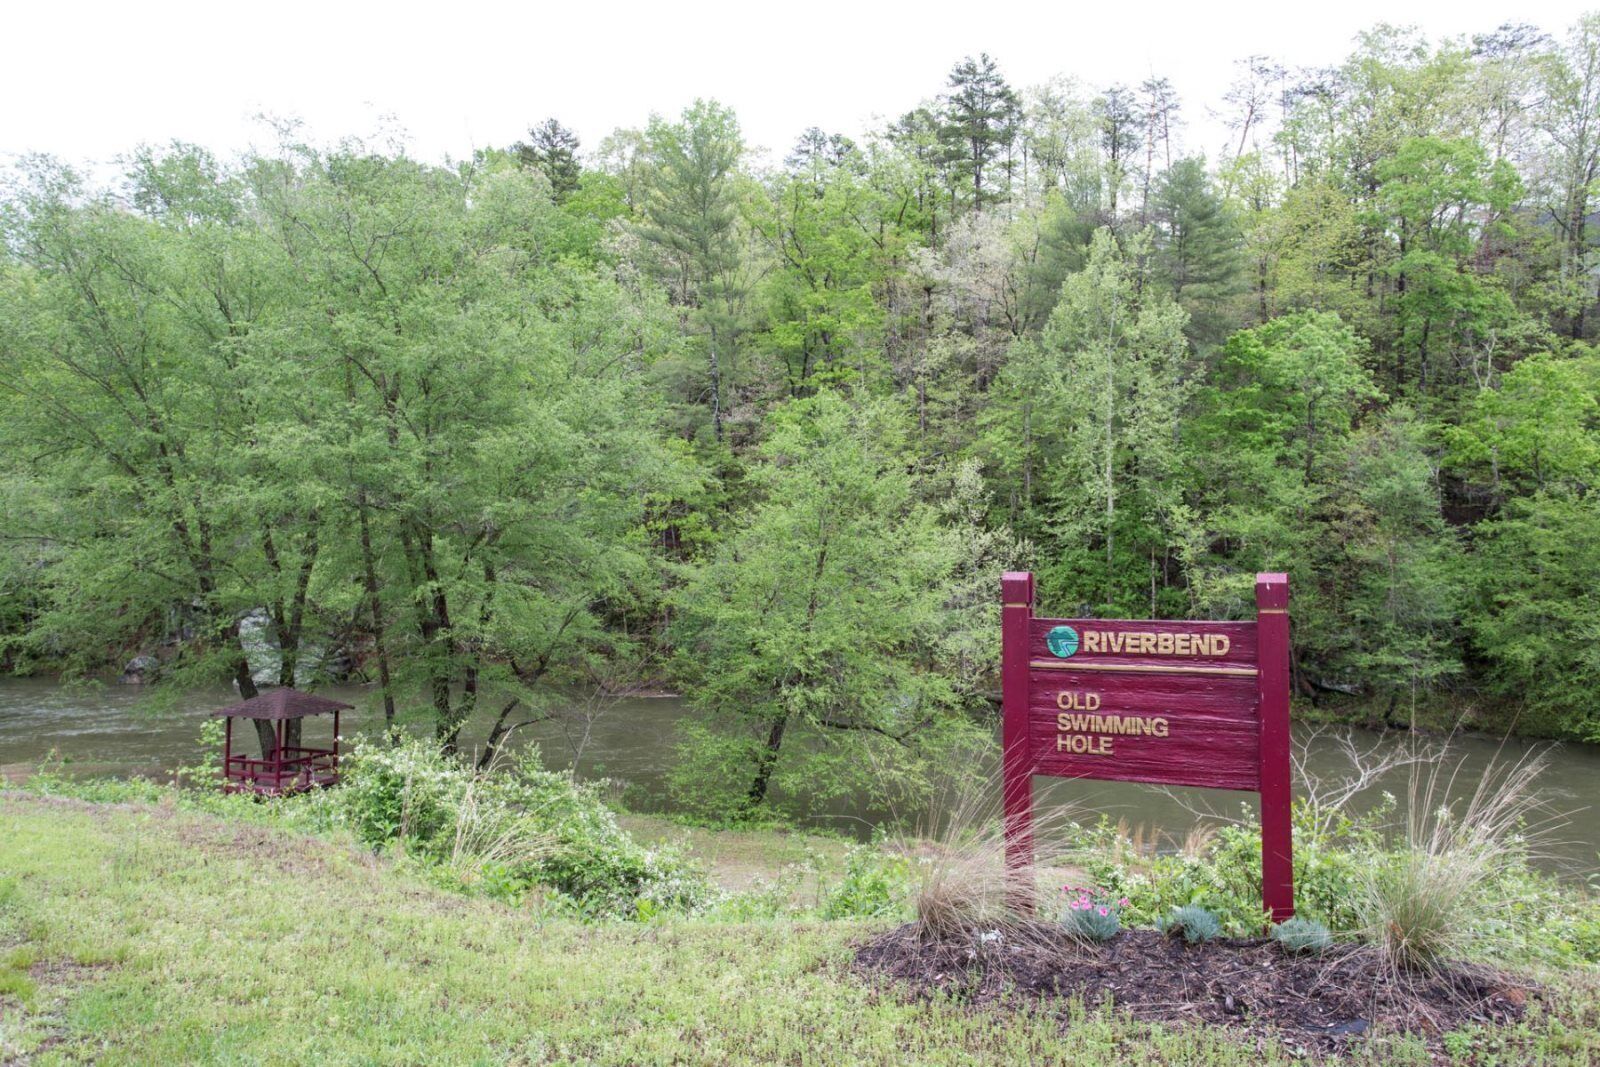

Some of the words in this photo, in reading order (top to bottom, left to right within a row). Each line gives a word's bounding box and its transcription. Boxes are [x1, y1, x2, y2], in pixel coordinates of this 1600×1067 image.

[1083, 631, 1230, 656] RIVERBEND
[1056, 691, 1100, 711] OLD
[1056, 713, 1169, 737] SWIMMING
[1056, 734, 1114, 755] HOLE
